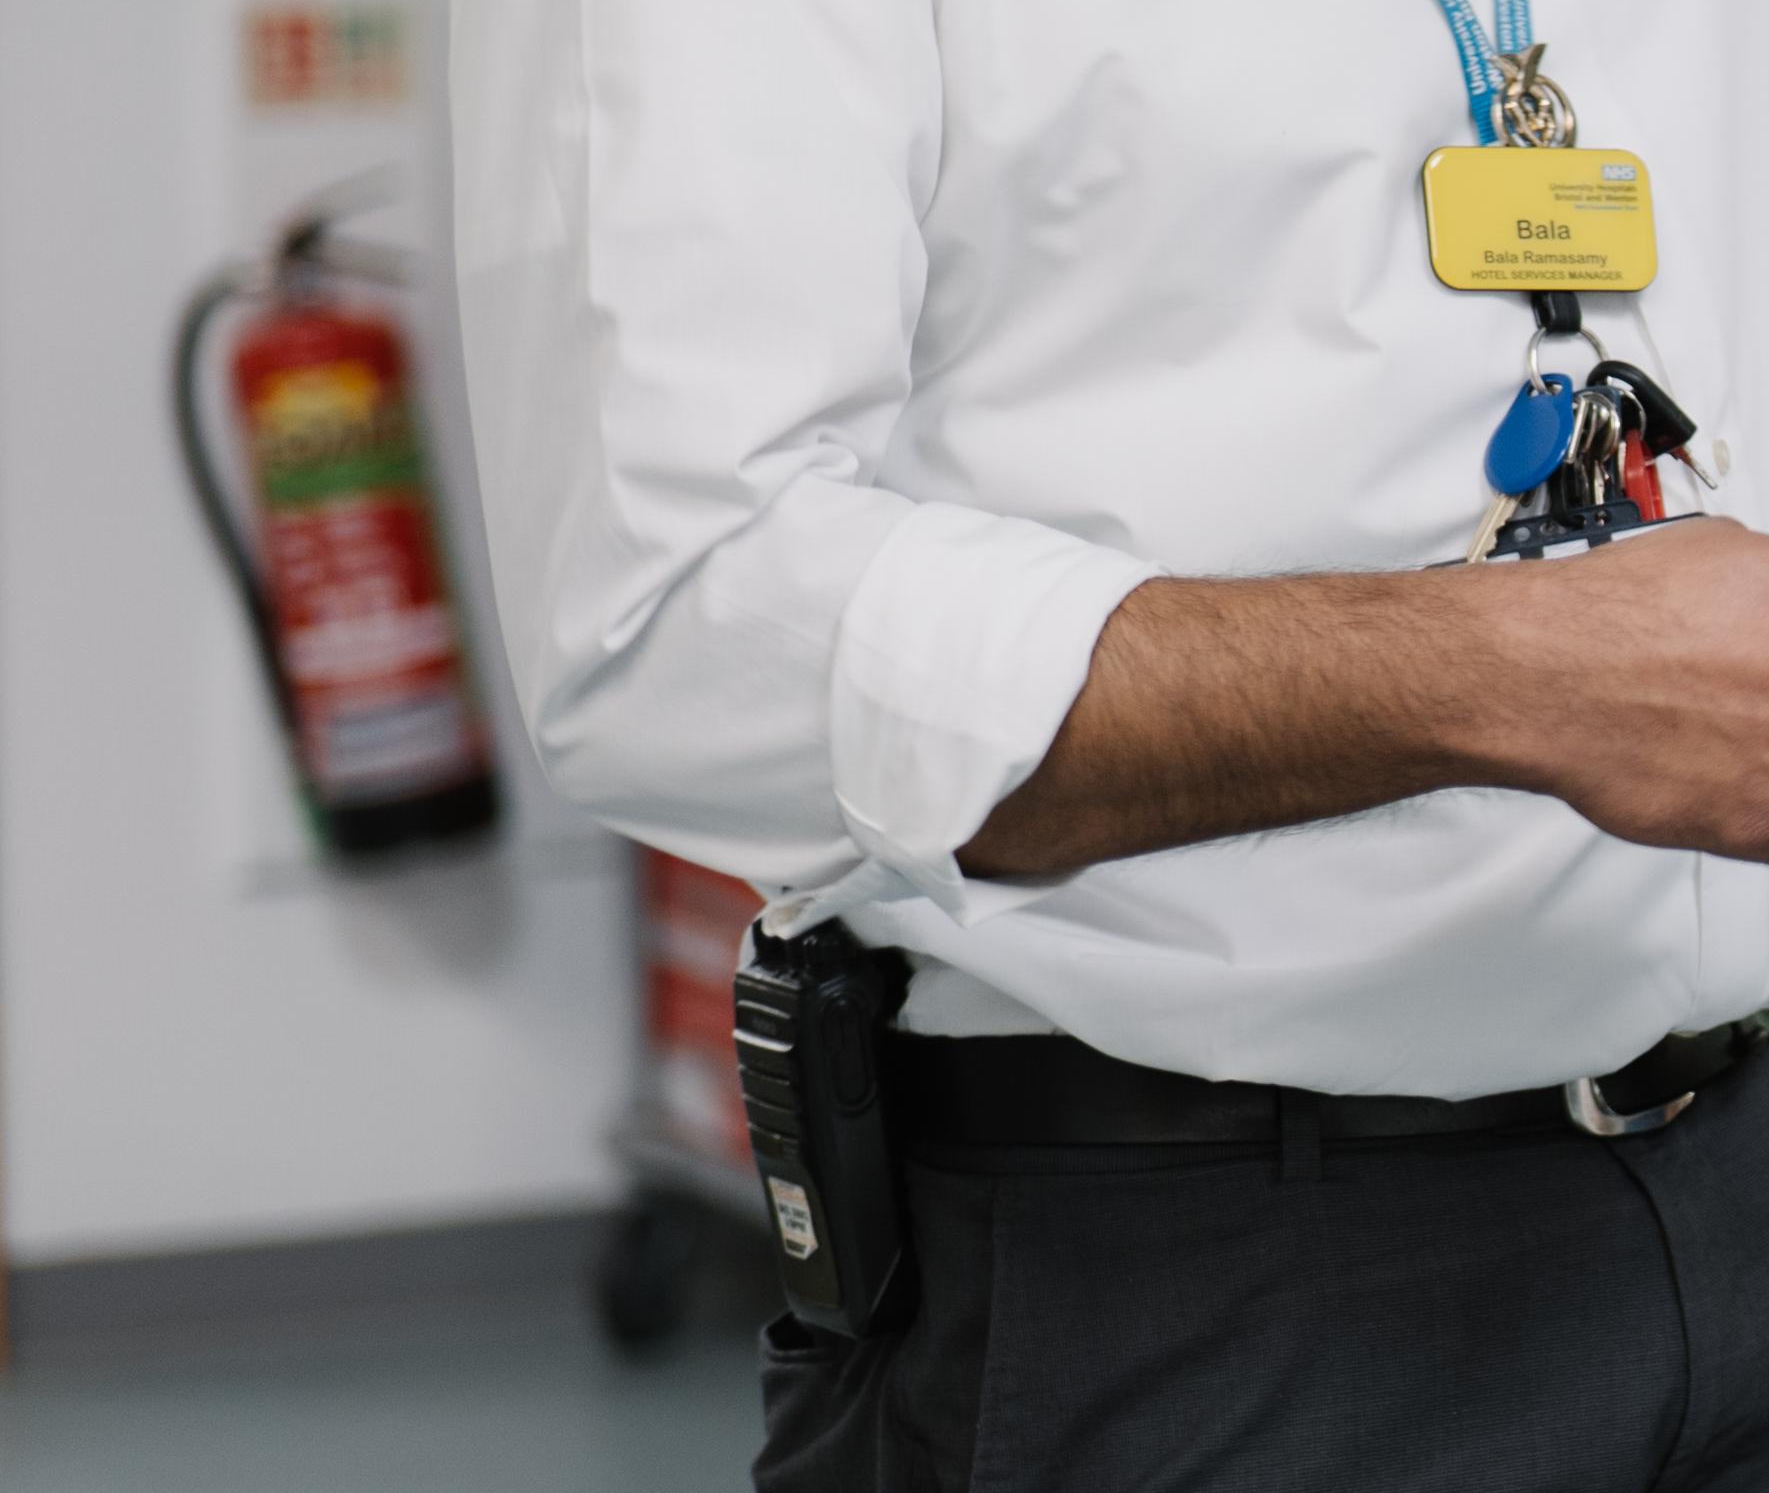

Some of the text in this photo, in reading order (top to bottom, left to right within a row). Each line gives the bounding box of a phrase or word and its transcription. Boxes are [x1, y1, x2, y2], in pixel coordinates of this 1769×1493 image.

[1516, 219, 1571, 241] Bala
[1484, 250, 1608, 269] Bala Ramasamy
[1471, 270, 1623, 281] HOTEL SERVICES MANAGER
